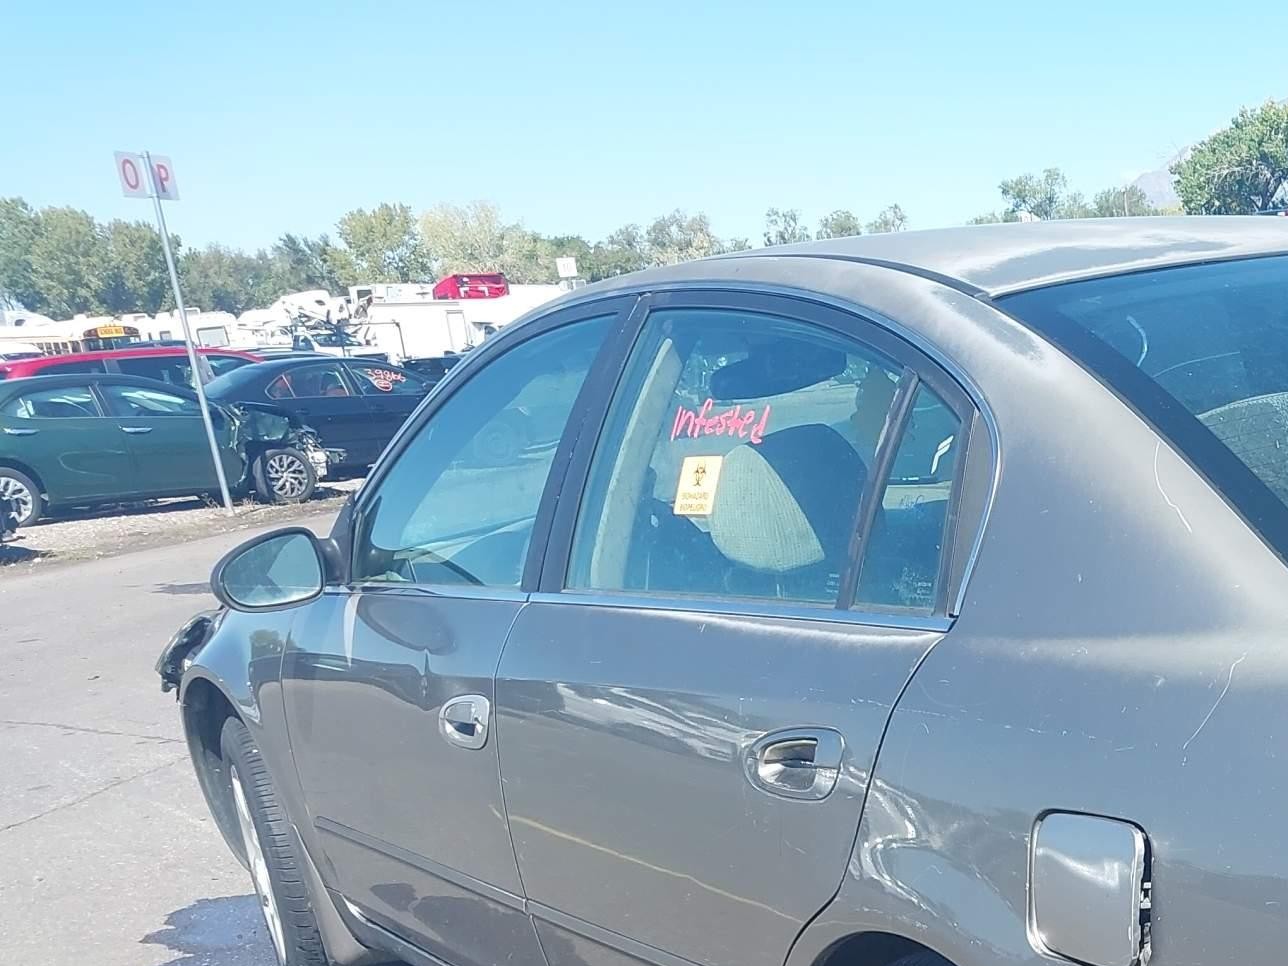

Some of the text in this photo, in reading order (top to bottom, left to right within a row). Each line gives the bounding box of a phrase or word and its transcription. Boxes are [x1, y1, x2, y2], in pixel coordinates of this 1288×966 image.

[122, 159, 139, 190] O
[156, 163, 169, 192] P
[670, 398, 770, 444] Infested
